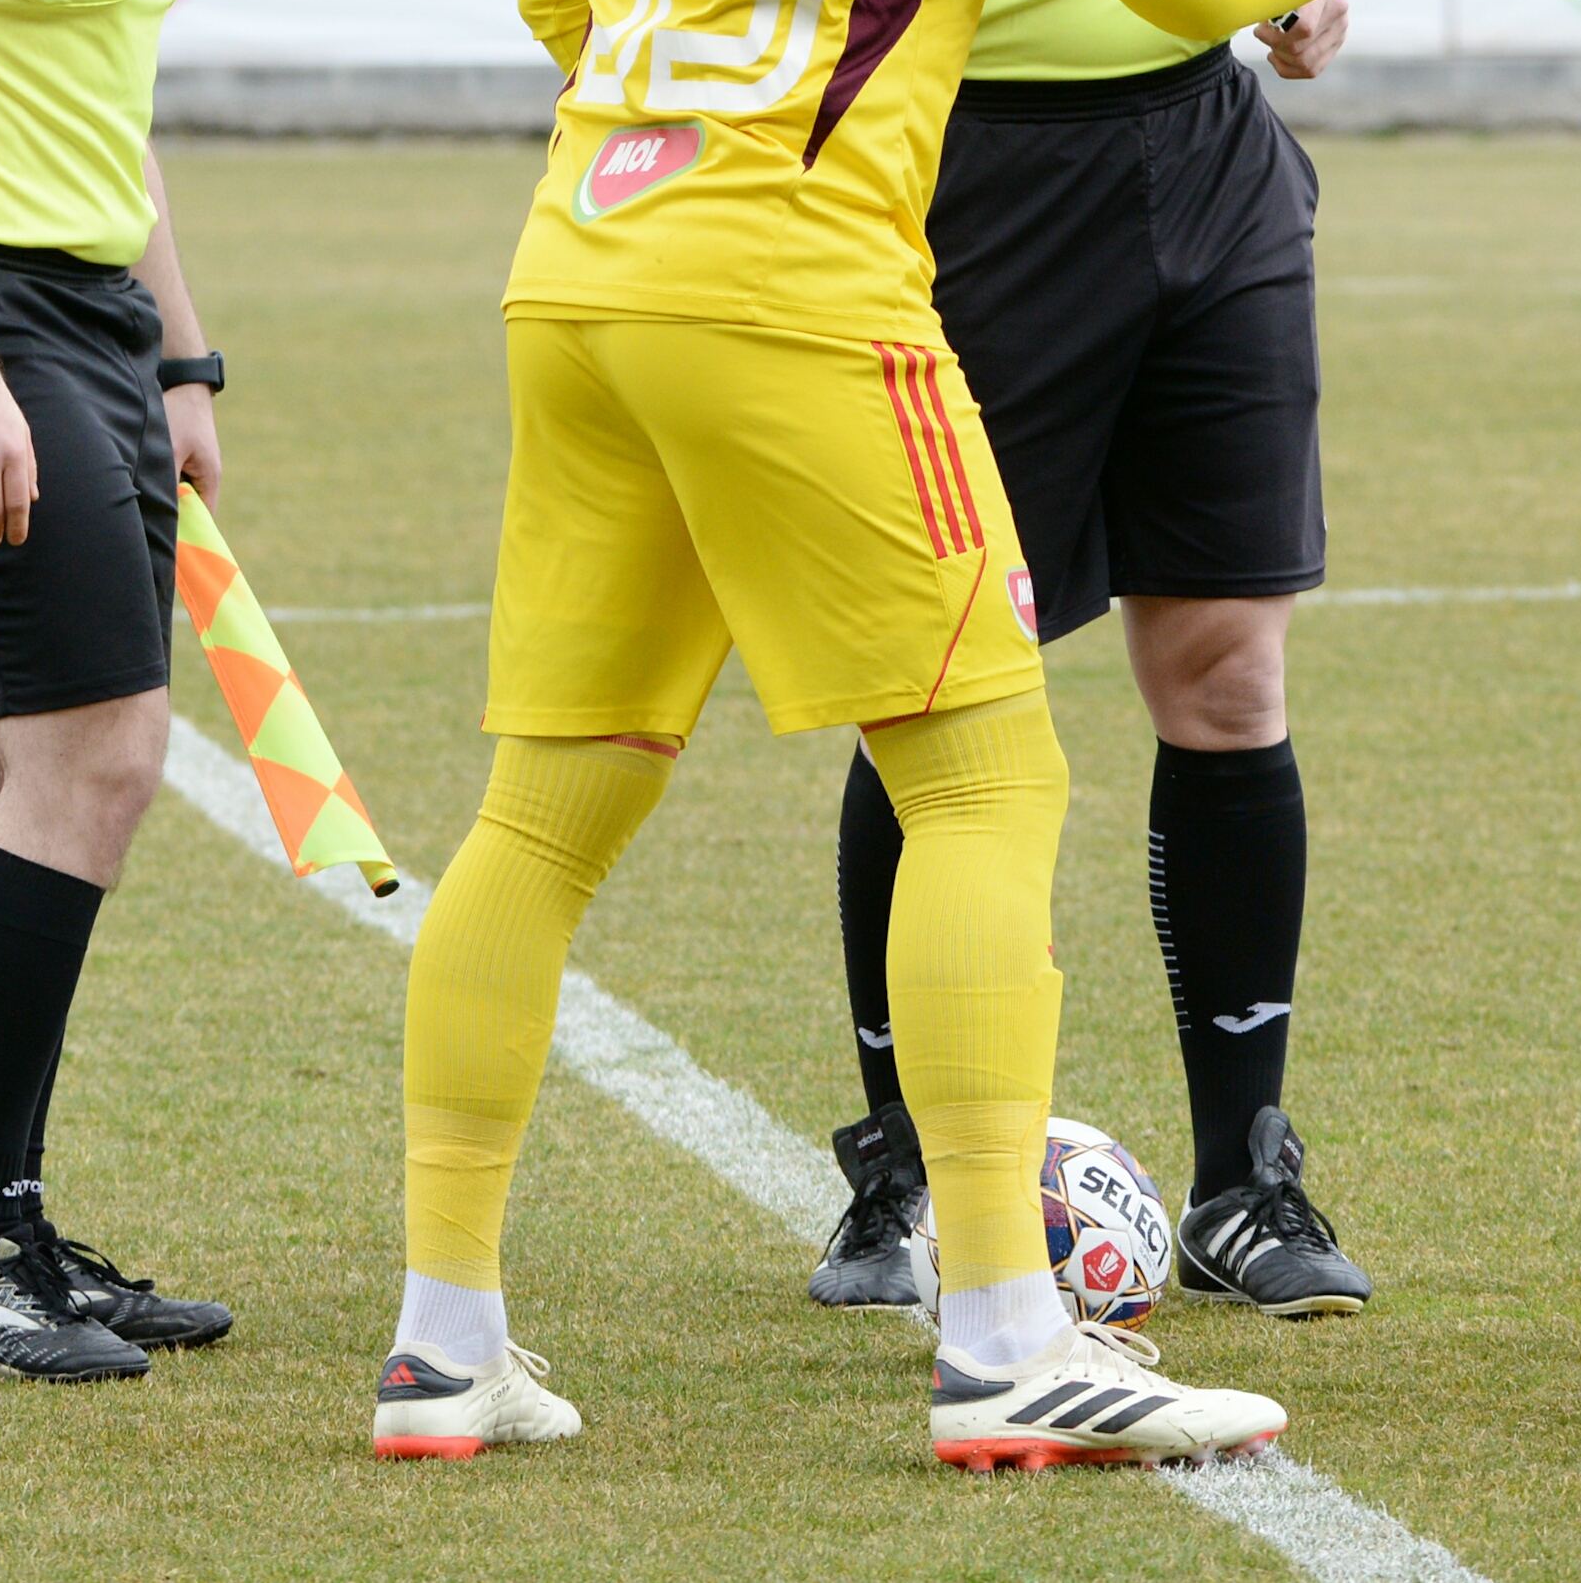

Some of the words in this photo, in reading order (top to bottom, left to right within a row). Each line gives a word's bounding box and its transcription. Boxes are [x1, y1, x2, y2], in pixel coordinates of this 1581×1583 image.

[599, 137, 667, 176] MOL
[1017, 577, 1035, 606] MO
[1079, 1166, 1169, 1267] SELECT
